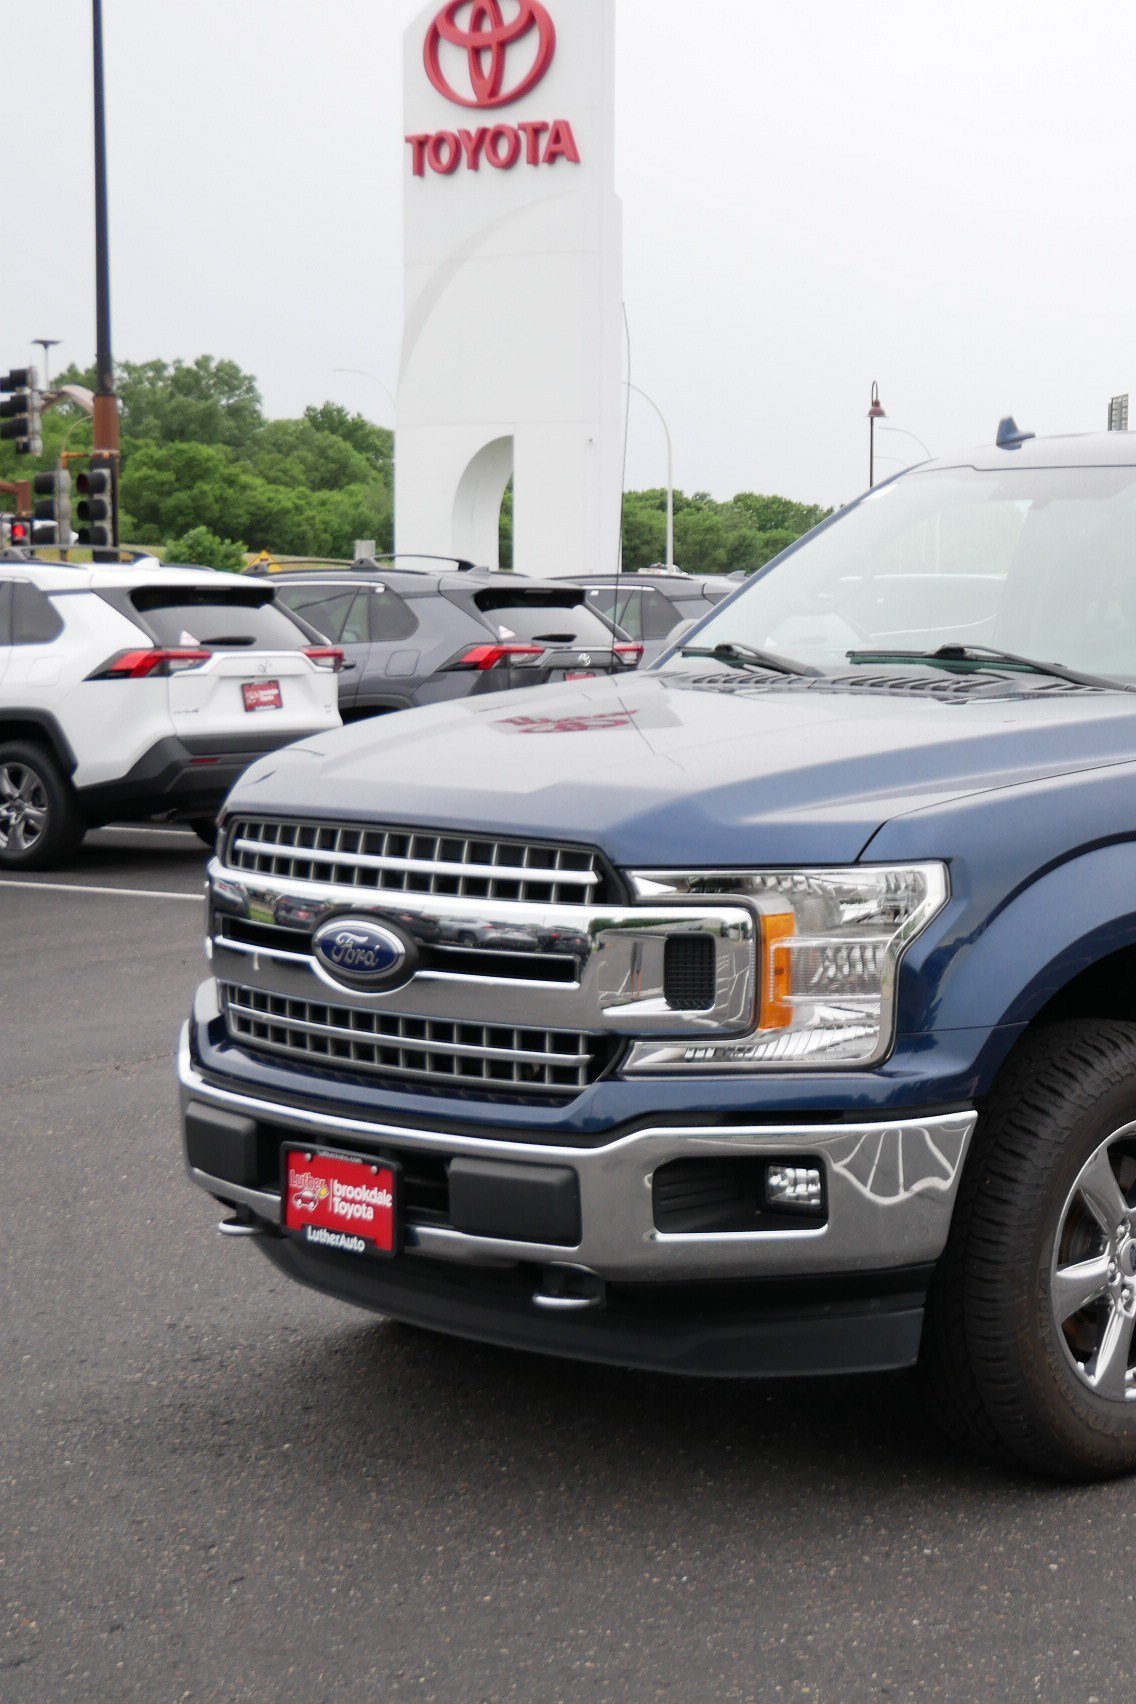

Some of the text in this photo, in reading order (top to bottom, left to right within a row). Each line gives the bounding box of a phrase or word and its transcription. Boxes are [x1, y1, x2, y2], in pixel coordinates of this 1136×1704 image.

[405, 119, 581, 177] TOYOTA
[331, 932, 381, 968] Ford
[333, 1179, 393, 1208] brookdale
[333, 1196, 375, 1220] Toyota
